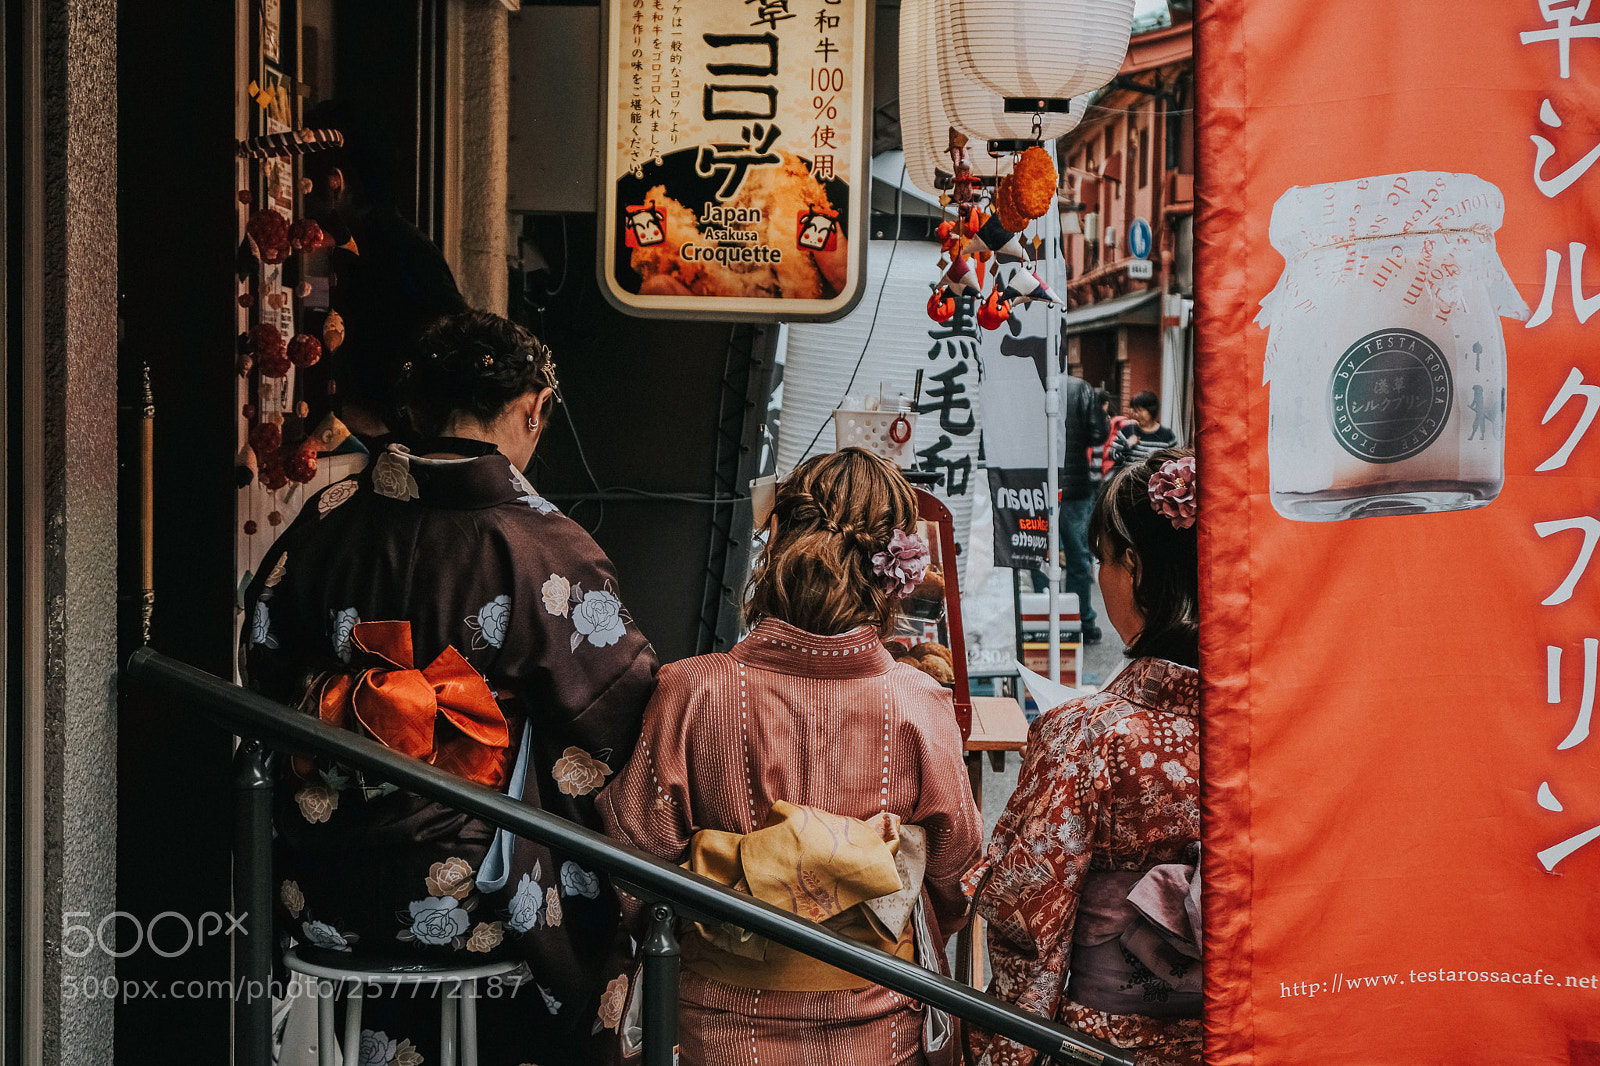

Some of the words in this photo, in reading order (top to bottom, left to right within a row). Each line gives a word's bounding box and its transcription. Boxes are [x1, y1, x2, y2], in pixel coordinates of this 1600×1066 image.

[669, 0, 683, 145] ケは一般的なコロッケより
[810, 0, 844, 178] 和牛100%使用
[701, 202, 761, 226] Japan
[705, 228, 758, 241] Asakusa
[681, 243, 782, 266] Croquette
[1338, 360, 1355, 379] by
[1364, 337, 1416, 354] TESTA
[1424, 353, 1446, 404] ROSSA
